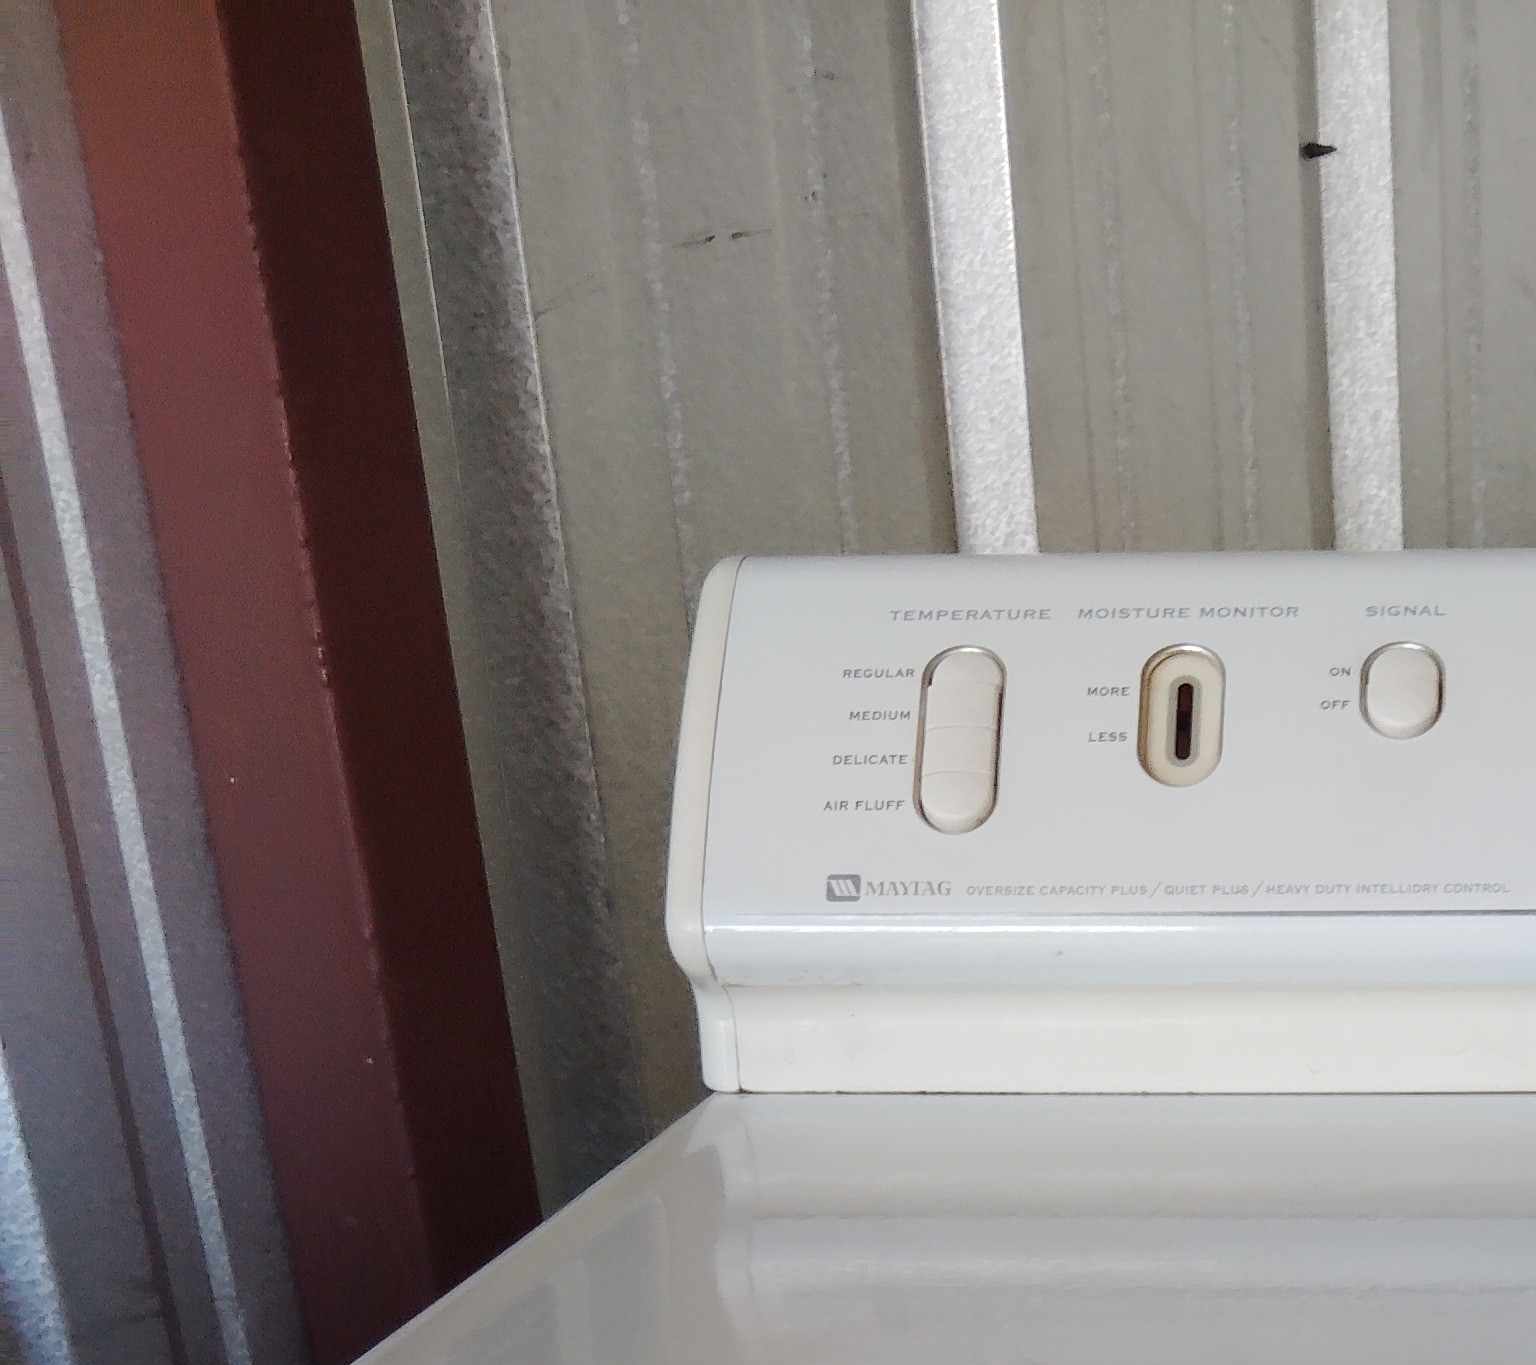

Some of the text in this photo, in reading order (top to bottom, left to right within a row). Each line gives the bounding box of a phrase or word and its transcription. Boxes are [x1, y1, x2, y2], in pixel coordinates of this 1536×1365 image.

[890, 608, 1052, 622] TEMPERATURE
[1077, 605, 1300, 620] MOISTURE MONITOR
[1365, 604, 1447, 618] SIGNAL
[842, 667, 916, 680] REGULAR
[1329, 667, 1352, 678] ON
[1086, 686, 1131, 697] MORE
[1320, 700, 1352, 711] OFF
[849, 710, 912, 721] MEDIUM
[1088, 731, 1129, 743] LESS
[832, 754, 909, 766] DELICATE
[824, 800, 907, 812] AIR FLUFF
[865, 881, 952, 897] MAYTAG
[966, 884, 1036, 897] OVERSIZE
[1039, 884, 1107, 896] CAPACITY
[1110, 884, 1148, 896] PLUS
[1164, 884, 1208, 896] QUIET
[1212, 884, 1250, 896] PLUS
[1266, 883, 1312, 895] HEAVY
[1314, 883, 1352, 895] DUTY
[1356, 882, 1441, 895] INTELLIDRY
[1443, 881, 1512, 895] CONTROL
